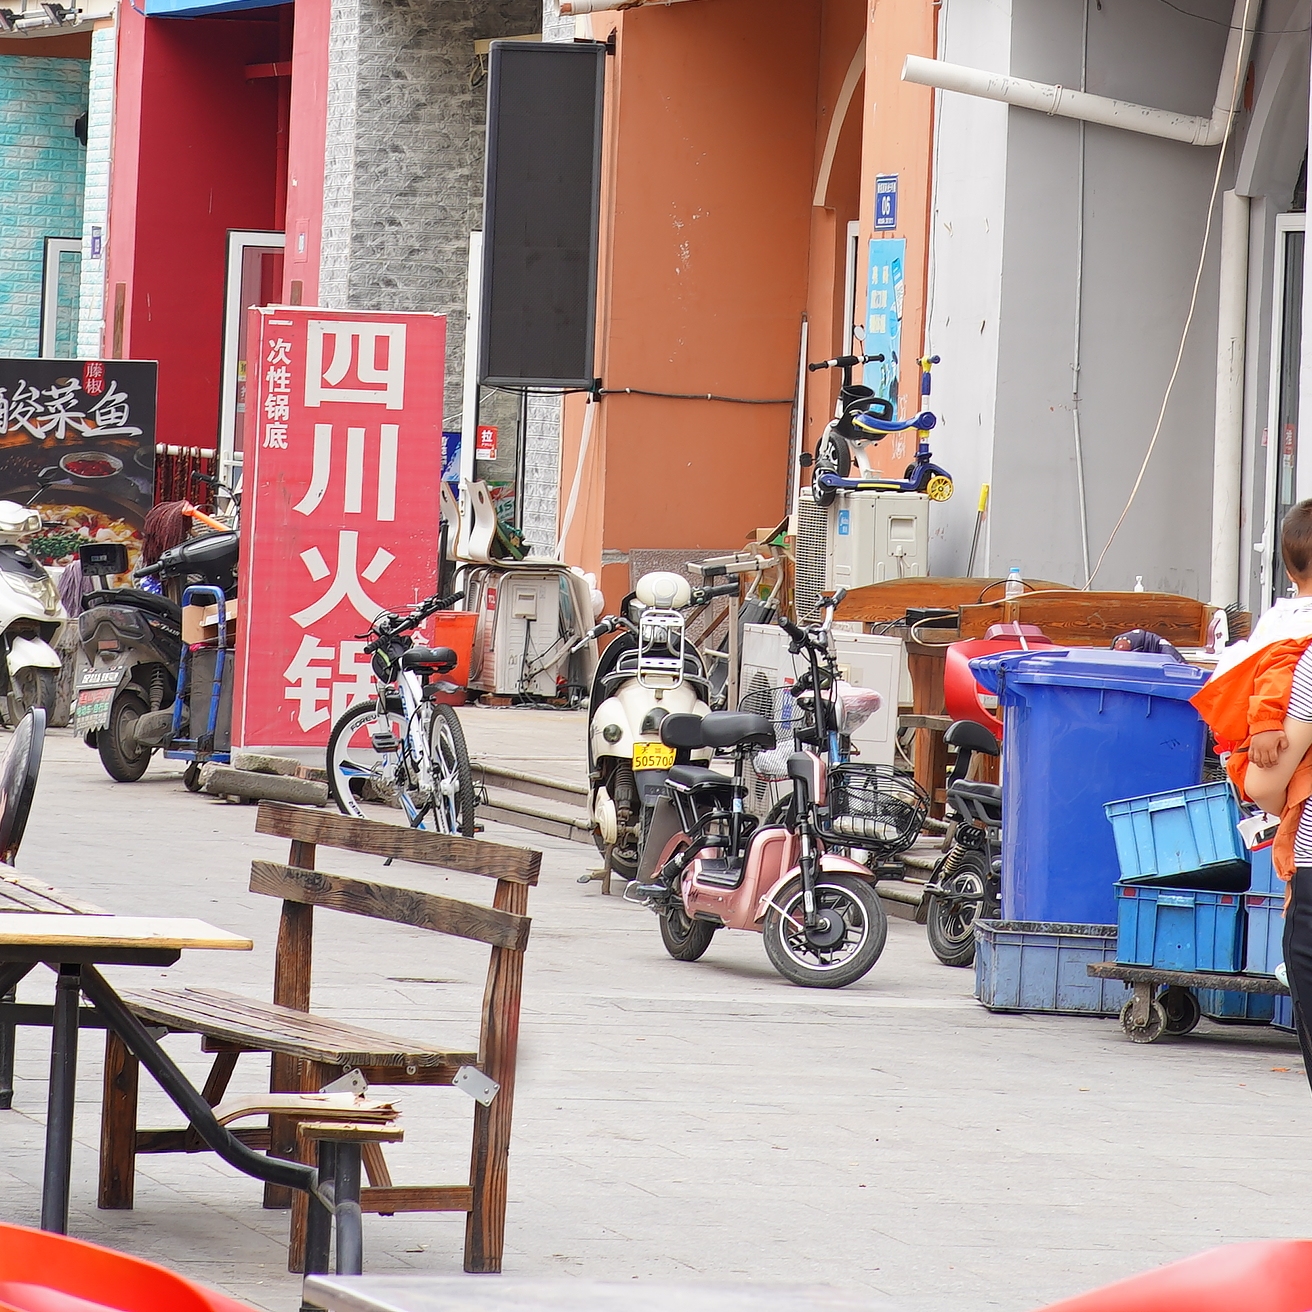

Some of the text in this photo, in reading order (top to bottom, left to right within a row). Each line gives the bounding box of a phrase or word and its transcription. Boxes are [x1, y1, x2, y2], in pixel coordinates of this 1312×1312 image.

[881, 194, 891, 216] 06
[85, 362, 103, 394] 藤椒
[262, 320, 294, 450] 一次性锅底
[481, 429, 494, 443] 拉
[282, 319, 409, 734] 四川火锅
